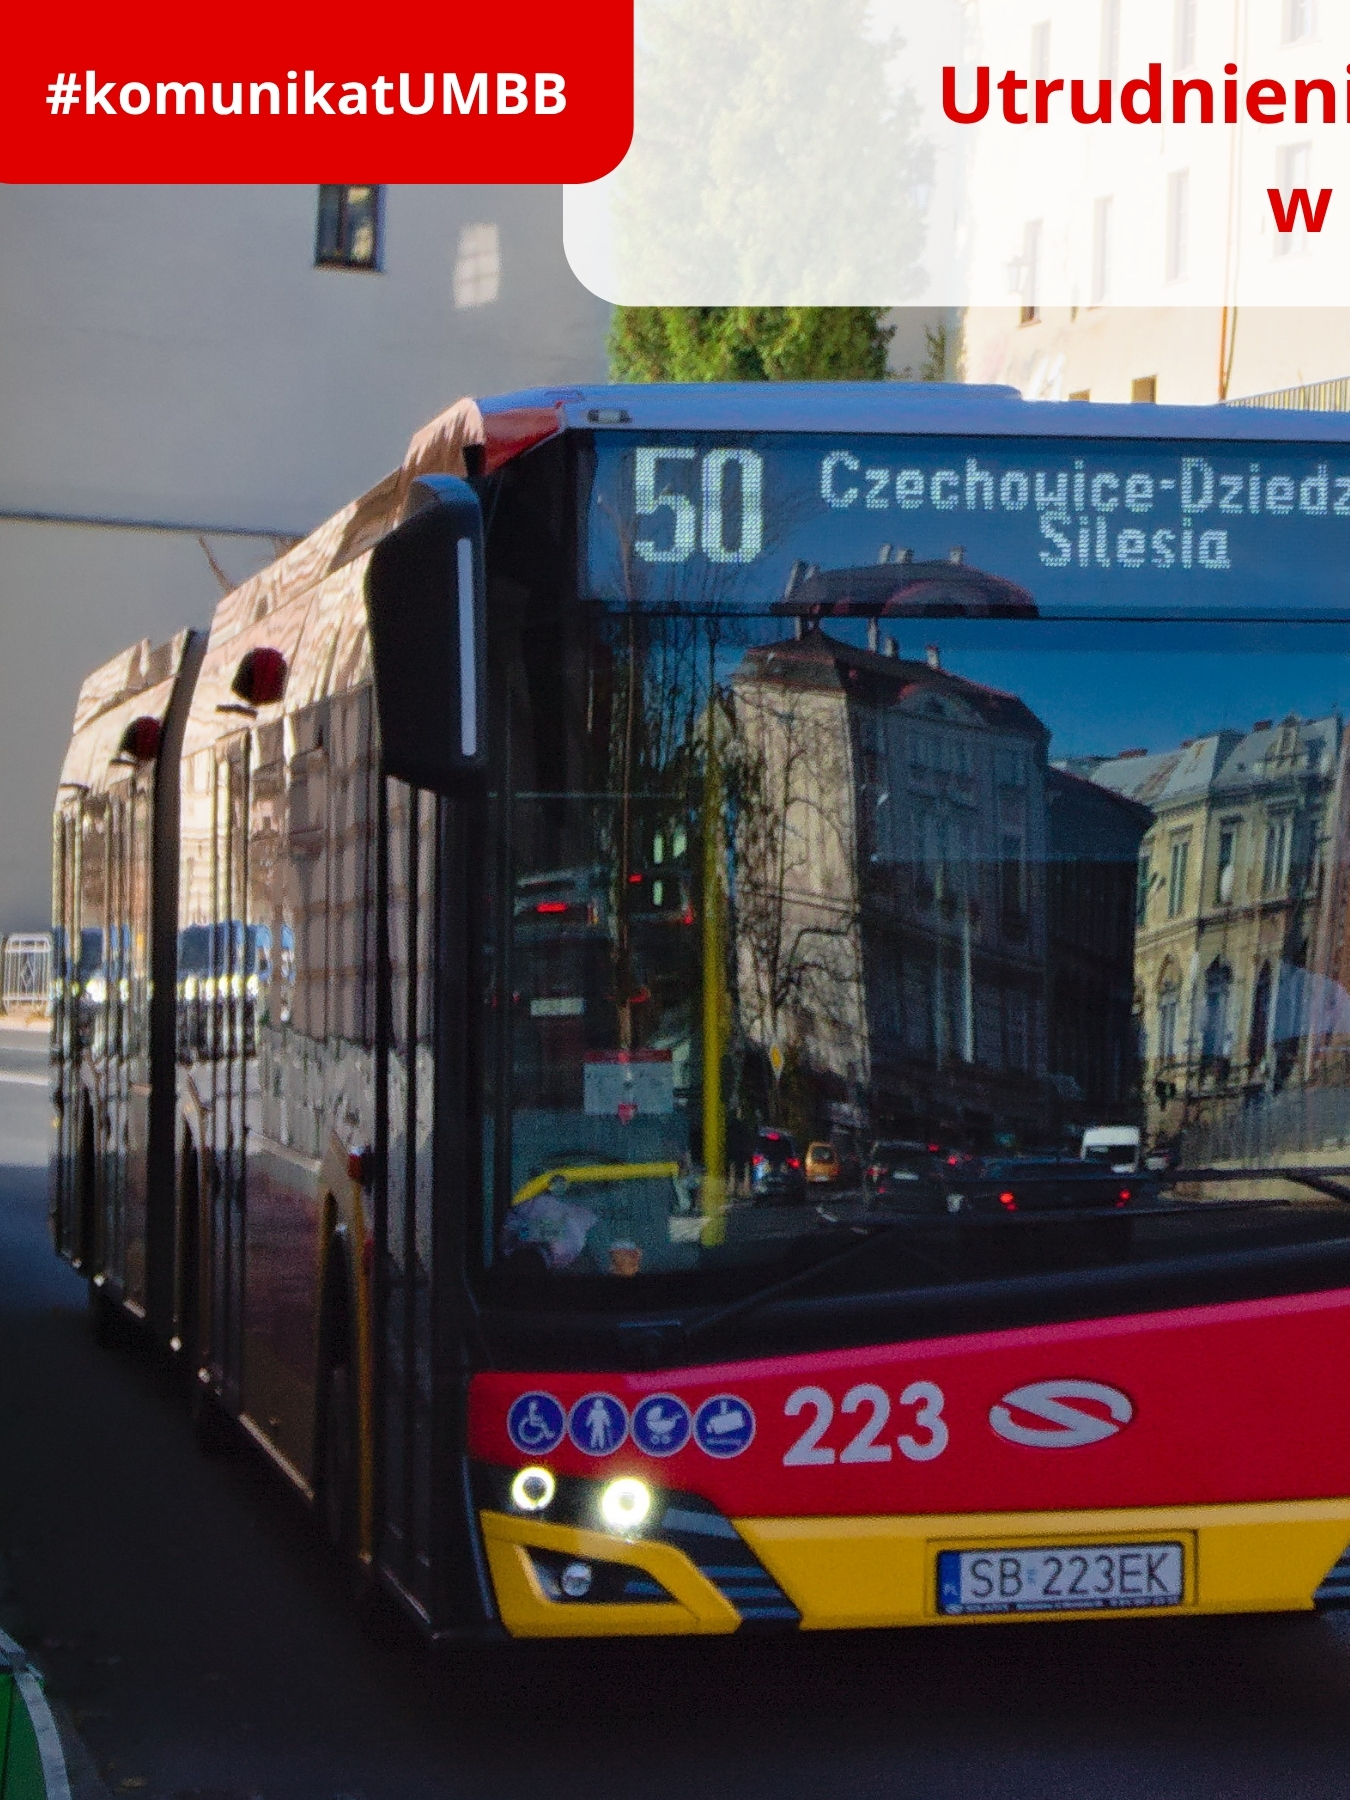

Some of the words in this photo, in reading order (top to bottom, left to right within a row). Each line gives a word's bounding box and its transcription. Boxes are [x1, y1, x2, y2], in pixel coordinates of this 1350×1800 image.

[634, 446, 764, 564] 50
[1037, 510, 1232, 570] Silesia
[783, 1380, 949, 1467] 223
[969, 1557, 1023, 1599] SB
[1041, 1551, 1169, 1597] 223EK
